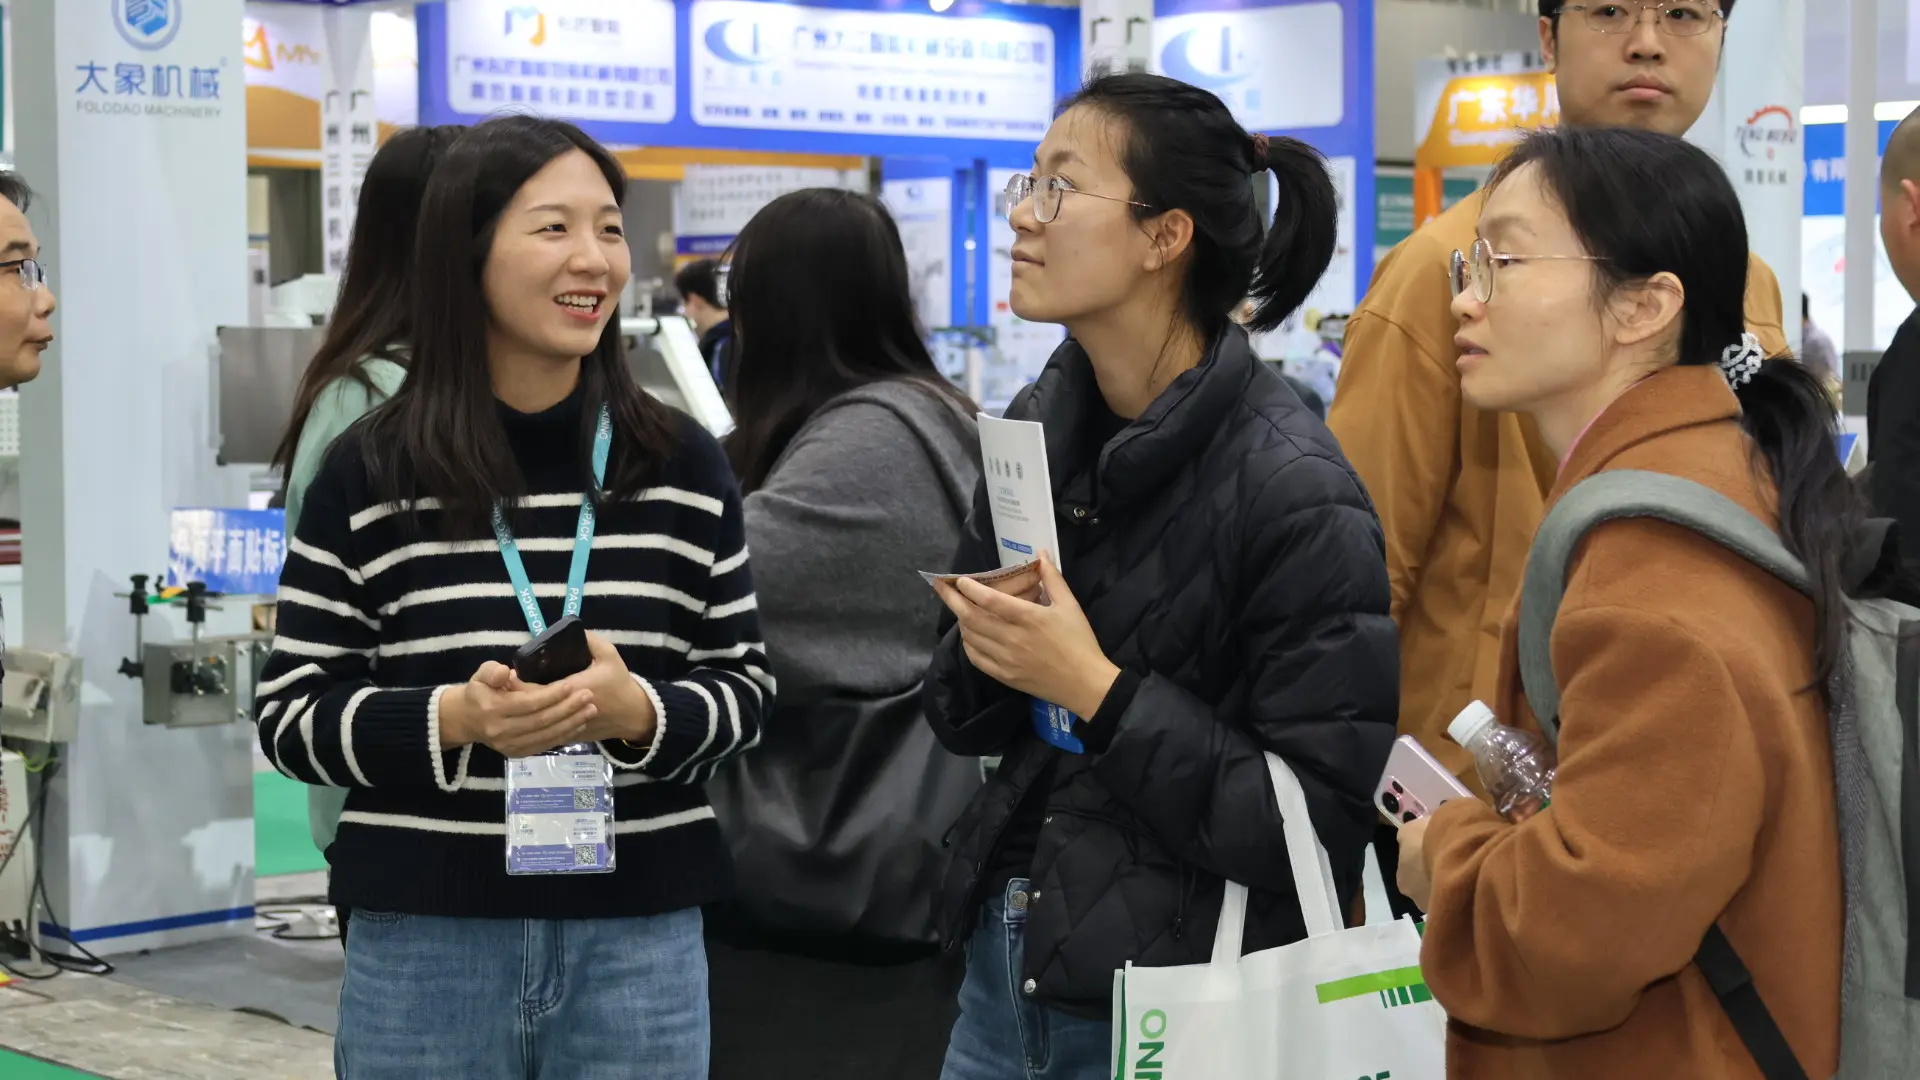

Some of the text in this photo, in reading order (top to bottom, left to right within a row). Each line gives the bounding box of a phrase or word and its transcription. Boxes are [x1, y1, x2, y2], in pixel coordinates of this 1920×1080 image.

[75, 60, 220, 99] 大象机械
[76, 100, 222, 118] FOLODAO MACHINERY
